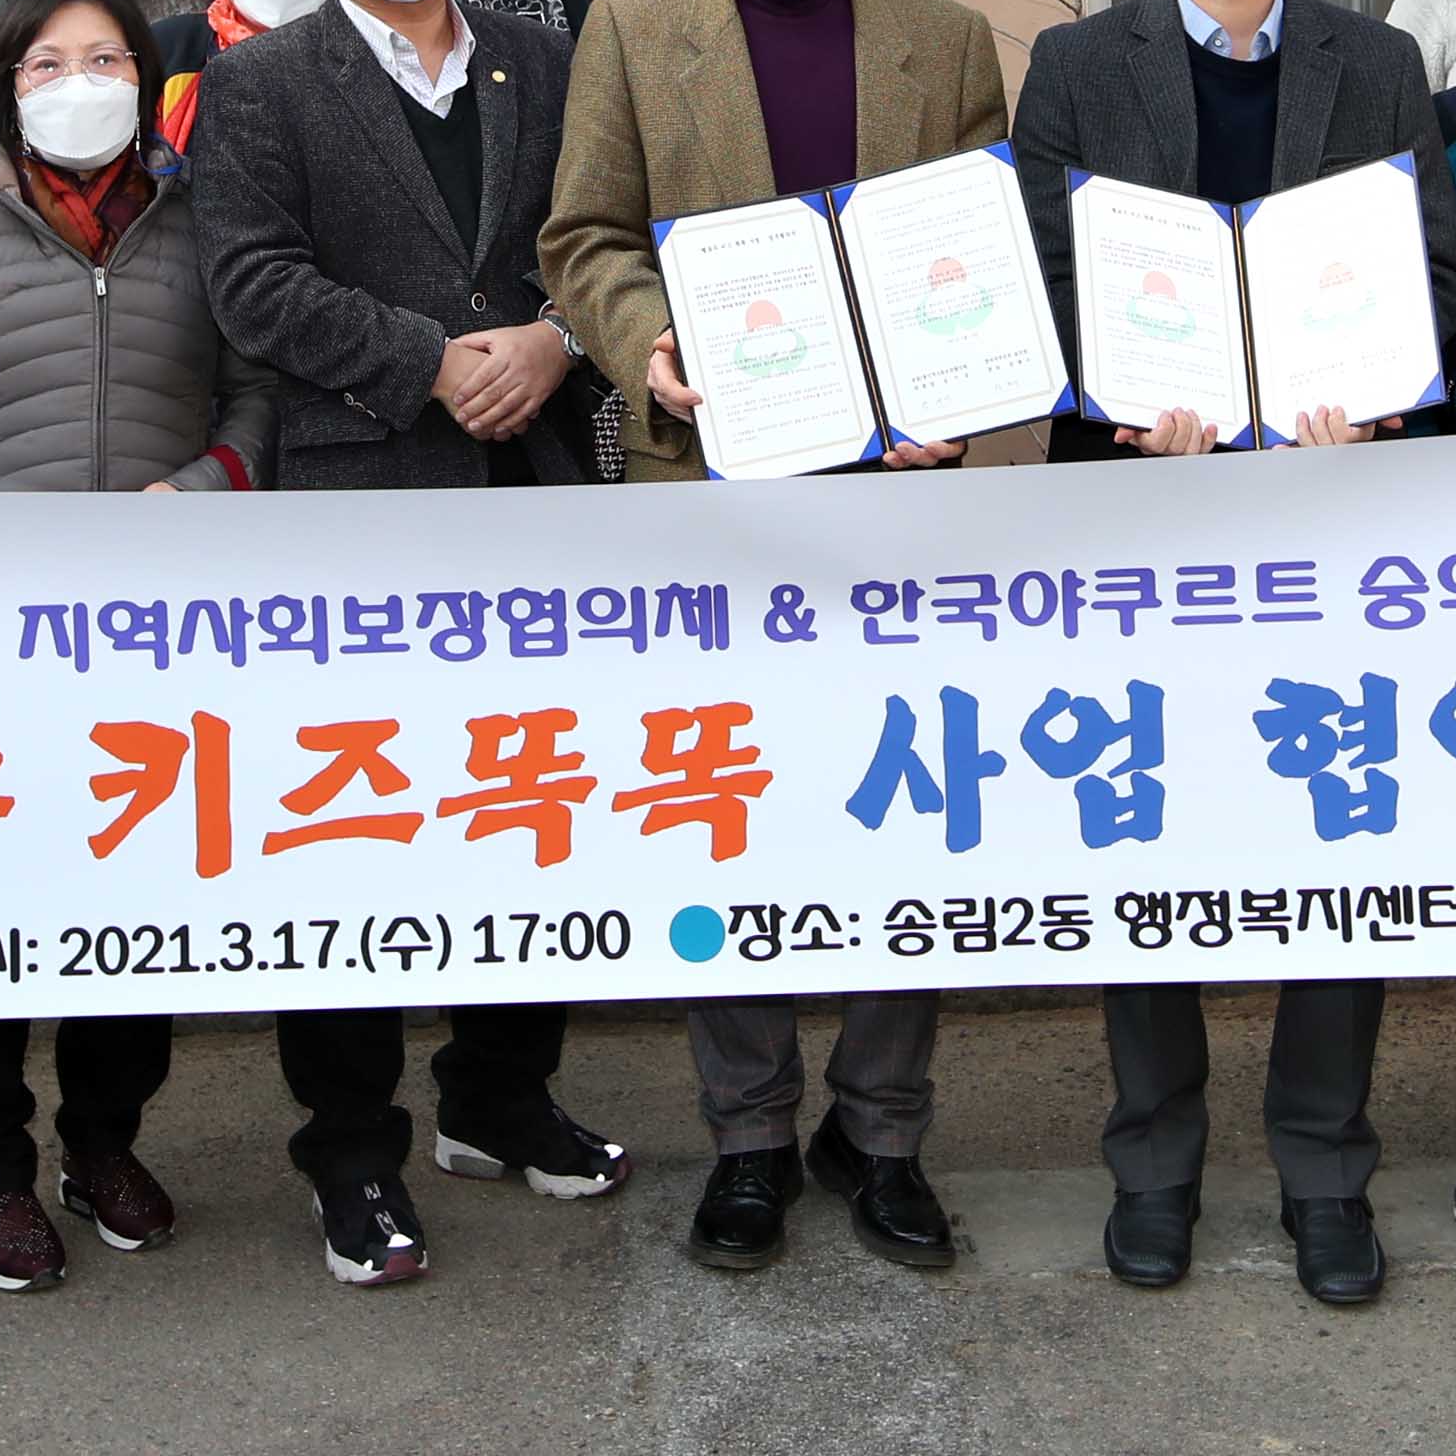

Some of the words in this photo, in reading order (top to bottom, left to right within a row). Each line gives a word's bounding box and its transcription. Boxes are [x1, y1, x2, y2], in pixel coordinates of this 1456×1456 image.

[19, 582, 730, 673] 지역사회보장협의체
[763, 584, 817, 643] &
[850, 558, 1323, 645] 한국야쿠르트
[88, 701, 774, 881] 키즈똑똑
[845, 679, 1166, 853] 사업
[59, 913, 452, 976] 2021.3.17.(수)
[473, 910, 631, 964] 17:00
[728, 900, 861, 962] 장소:
[883, 894, 1094, 957] 송림2동
